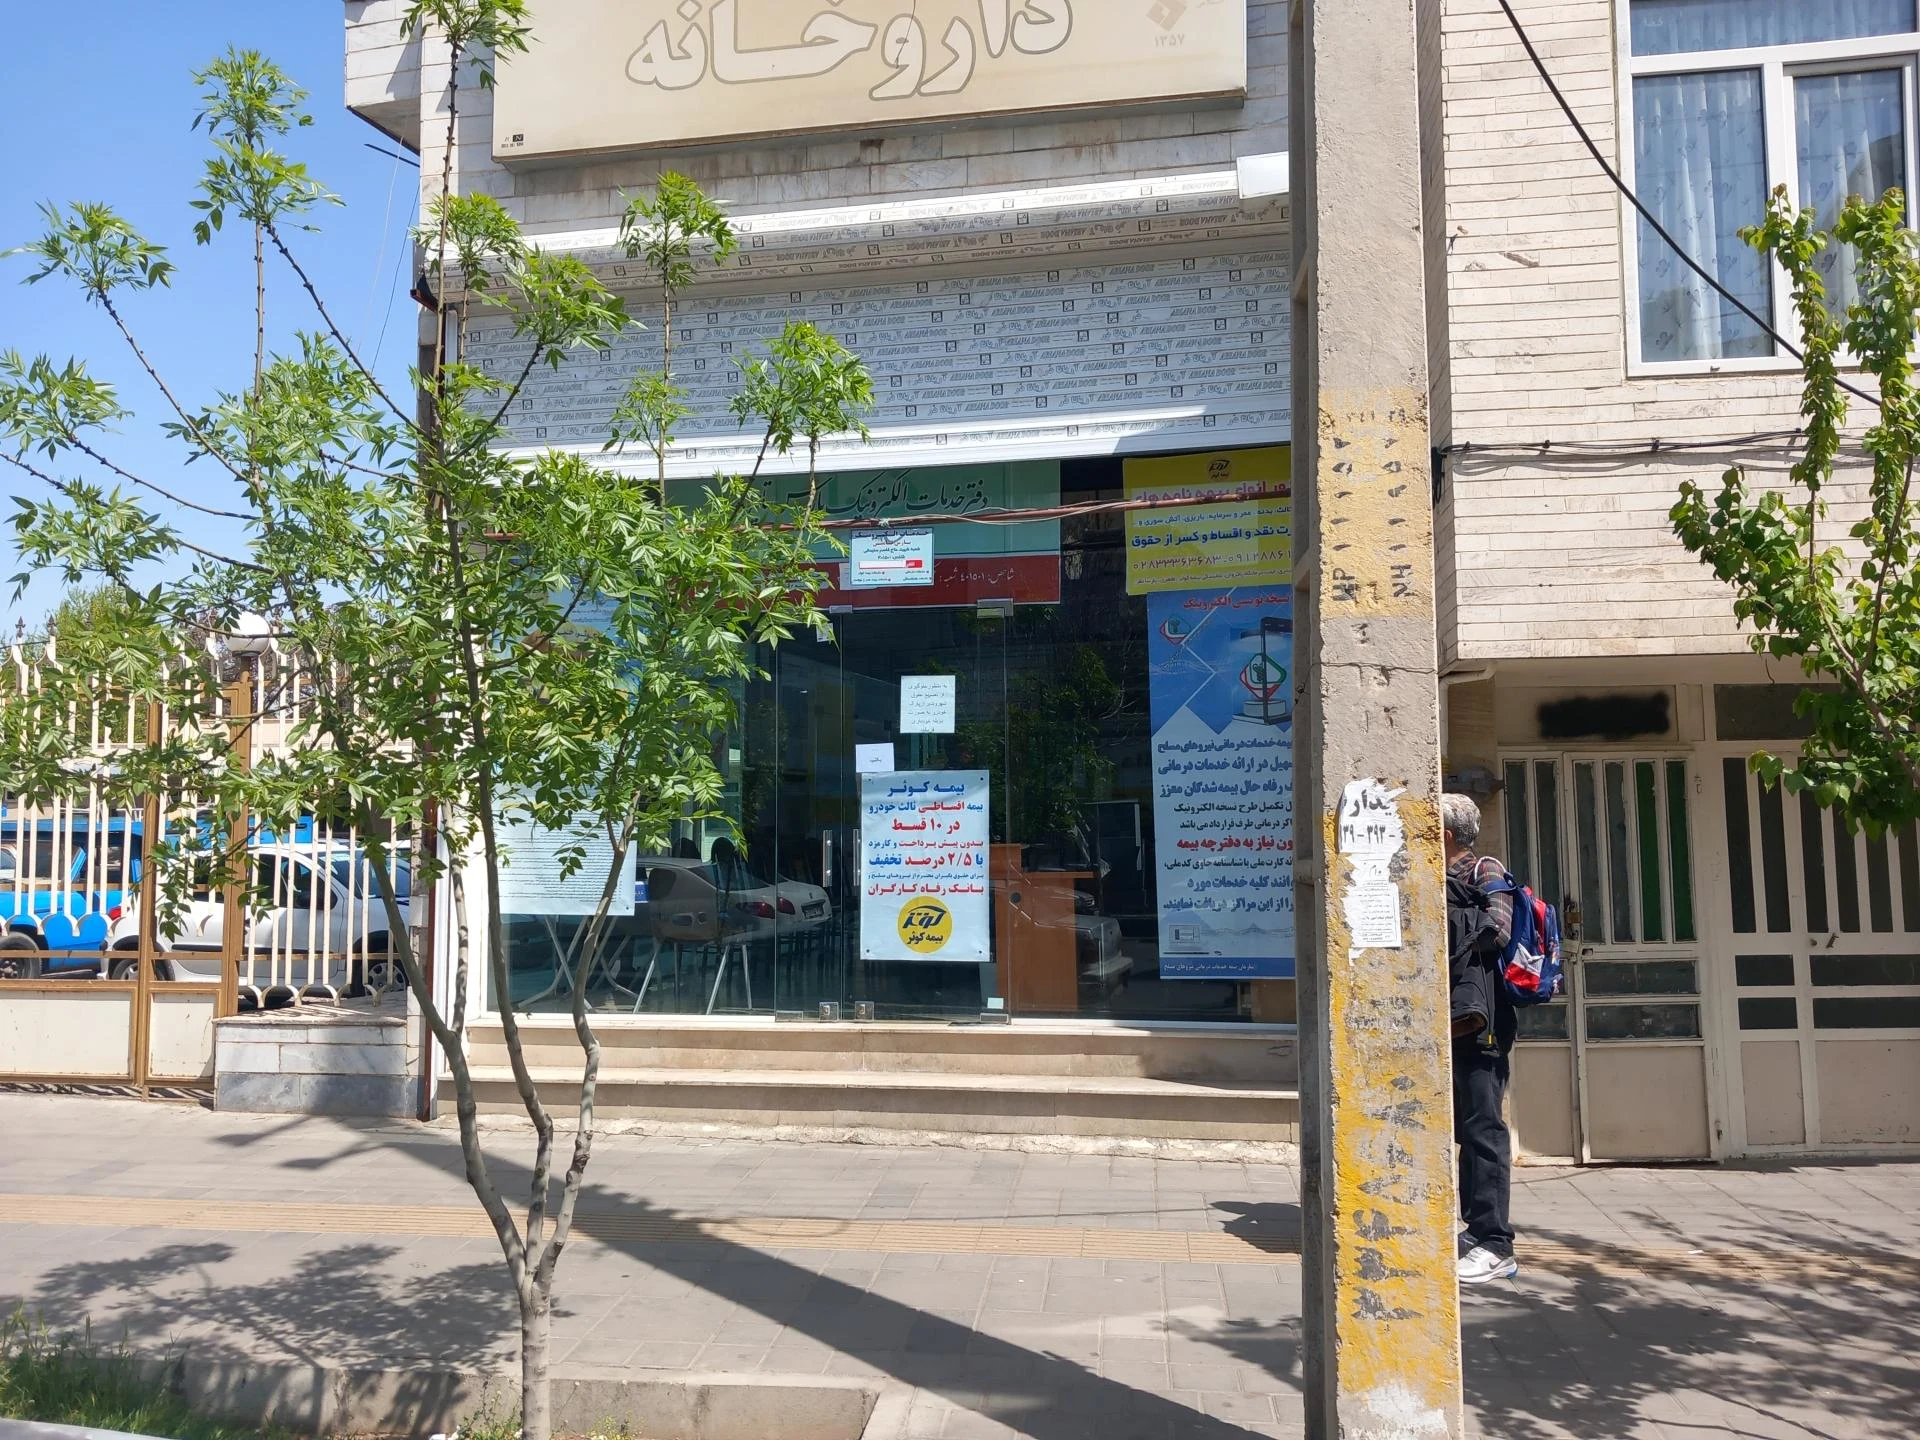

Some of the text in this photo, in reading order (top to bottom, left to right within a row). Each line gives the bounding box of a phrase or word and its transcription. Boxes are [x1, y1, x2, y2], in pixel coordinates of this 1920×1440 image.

[907, 484, 965, 512] خدمات
[961, 480, 988, 513] دفتر
[1210, 528, 1242, 538] اقساط
[1245, 529, 1251, 538] و
[1254, 526, 1274, 537] نقد
[1132, 536, 1161, 548] حقوق
[1164, 534, 1173, 546] از
[1176, 532, 1199, 545] کسر
[1202, 534, 1208, 543] و
[1158, 741, 1181, 753] مسلح
[1158, 759, 1193, 774] درمانی
[1195, 758, 1230, 770] خدمات
[1232, 756, 1254, 772] ارائه
[1256, 759, 1268, 772] در
[887, 780, 964, 797] بیمه کوثر
[1160, 784, 1182, 798] معزز
[1218, 784, 1239, 795] بیمه
[1240, 780, 1260, 795] حال
[1263, 779, 1283, 795] رفاه
[869, 801, 983, 814] بیمه اقساطی ثالث خودرو
[1174, 802, 1214, 814] الکترونیک
[1239, 802, 1257, 813] طرح
[1259, 802, 1283, 812] تکمیل
[892, 818, 960, 834] در ۱۰ قسط
[1180, 820, 1195, 828] باشد
[1236, 819, 1253, 830] طرف
[1255, 819, 1280, 830] درمانی
[869, 839, 891, 849] کارمزد
[899, 840, 937, 848] پرداخت
[938, 839, 958, 848] پیش
[960, 840, 983, 848] بدون
[1177, 839, 1199, 851] بیمه
[1243, 838, 1254, 850] به
[1256, 835, 1275, 851] نیاز
[869, 853, 902, 868] تخفیف
[905, 855, 945, 869] درصد
[975, 853, 983, 868] با
[1182, 858, 1191, 867] کد
[1250, 858, 1265, 868] ملی
[1266, 858, 1284, 868] کارت
[1187, 878, 1211, 891] مورد
[1212, 875, 1248, 888] خدمات
[1249, 875, 1270, 890] کلیه
[868, 883, 984, 896] بانک رفاه کارگران
[1231, 896, 1256, 912] مراکز
[1258, 897, 1273, 911] این
[1275, 897, 1285, 912] از
[907, 930, 944, 945] بیمه کوثر
